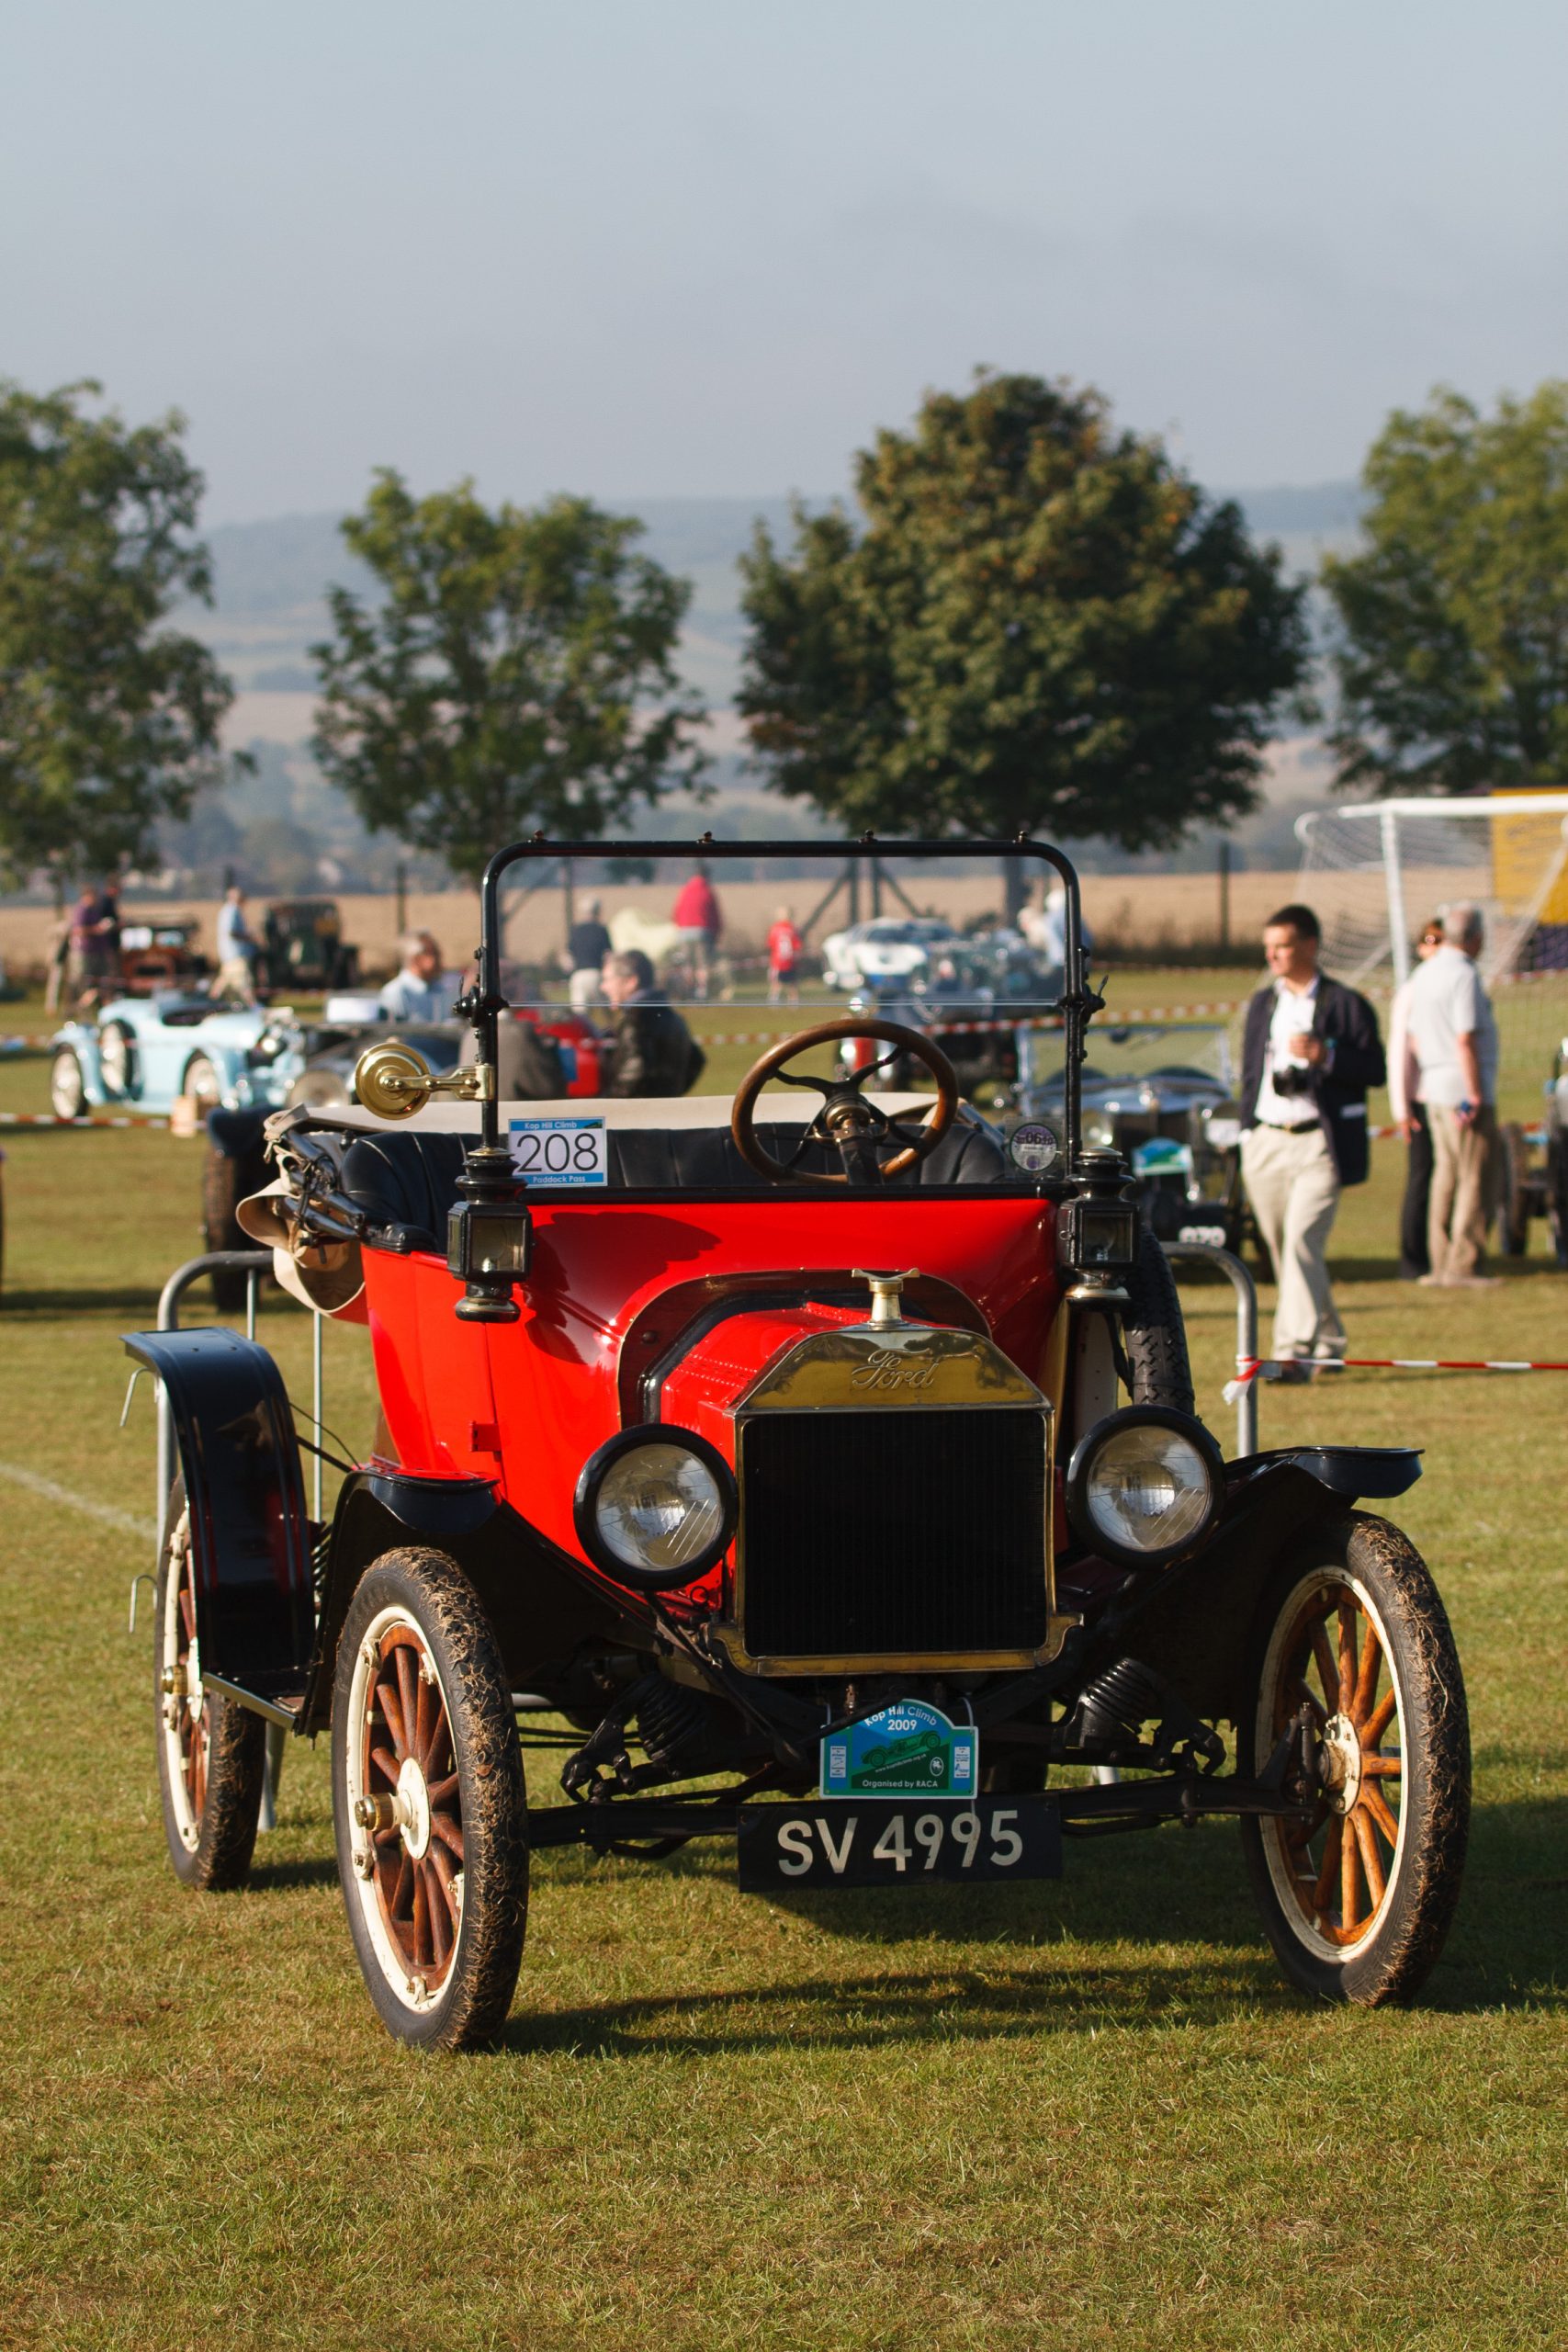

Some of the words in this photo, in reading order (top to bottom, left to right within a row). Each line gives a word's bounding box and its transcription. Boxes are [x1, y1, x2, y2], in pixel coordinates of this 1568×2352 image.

[517, 1133, 598, 1172] 208
[851, 1348, 941, 1390] Ford
[864, 1711, 886, 1726] Kop
[888, 1705, 905, 1716] Hill
[908, 1706, 937, 1725] Climb
[887, 1719, 918, 1731] 2009
[862, 1779, 903, 1790] Organised
[904, 1779, 914, 1790] by
[915, 1780, 938, 1788] RACA
[777, 1816, 858, 1876] SV
[873, 1809, 1023, 1871] 4995
